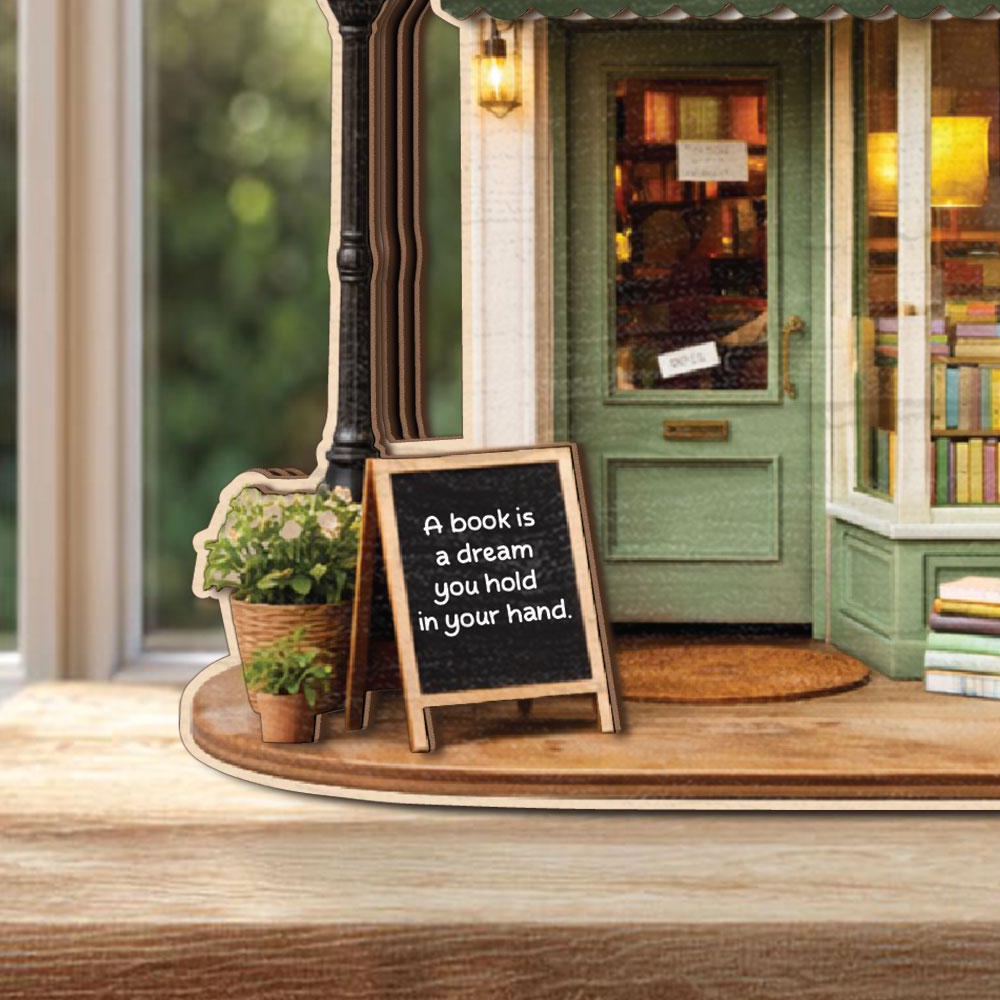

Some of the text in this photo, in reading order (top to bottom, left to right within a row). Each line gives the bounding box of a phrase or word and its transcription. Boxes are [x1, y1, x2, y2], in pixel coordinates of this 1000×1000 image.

[423, 507, 535, 536] A book is
[435, 543, 533, 566] a dream
[434, 569, 537, 605] you hold
[418, 599, 572, 637] in your hand.
